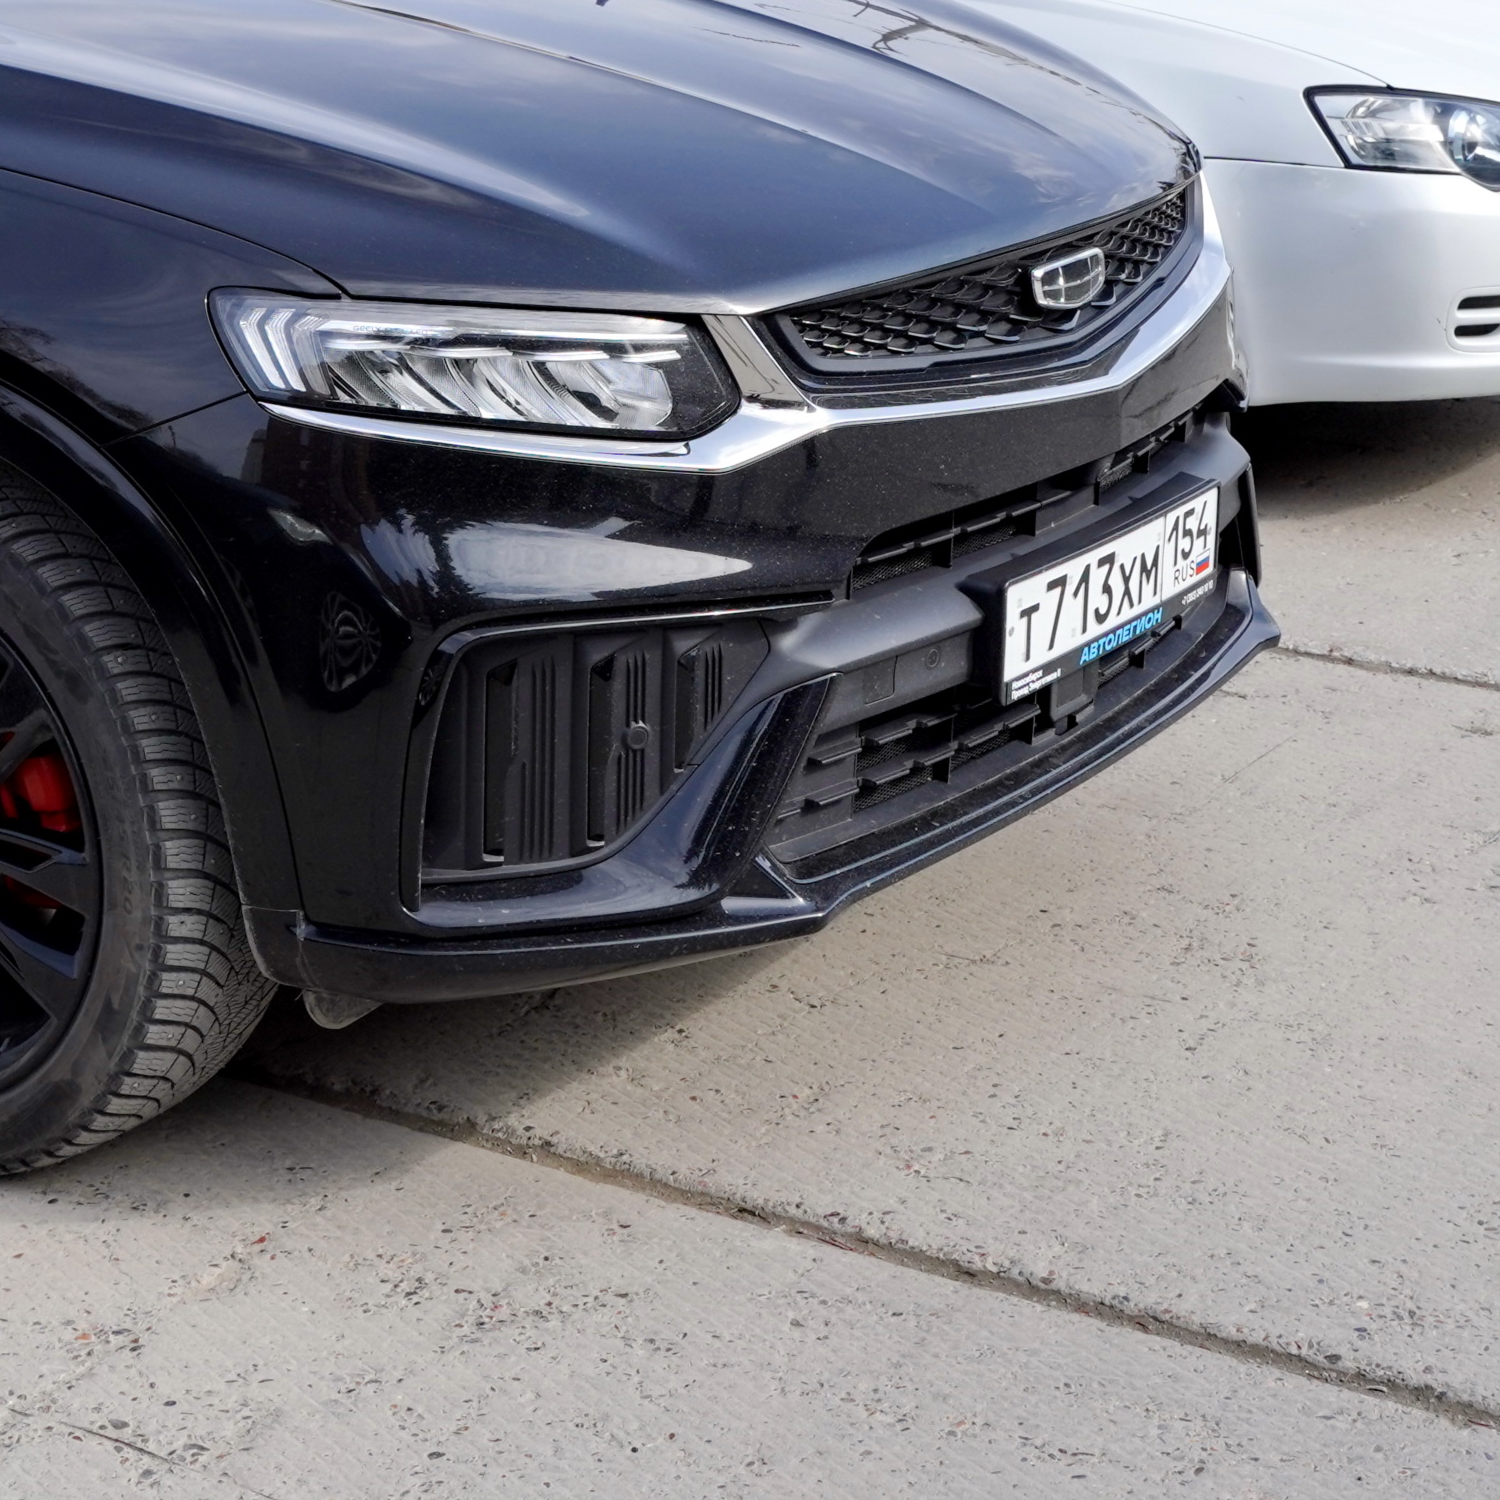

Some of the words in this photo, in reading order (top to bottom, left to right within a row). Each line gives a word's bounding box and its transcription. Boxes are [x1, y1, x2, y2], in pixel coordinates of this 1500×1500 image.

[1019, 544, 1161, 663] Т713ХМ
[1167, 500, 1209, 567] 154
[1173, 560, 1195, 588] RUS
[1079, 607, 1163, 666] АВТОЛЕГИОН
